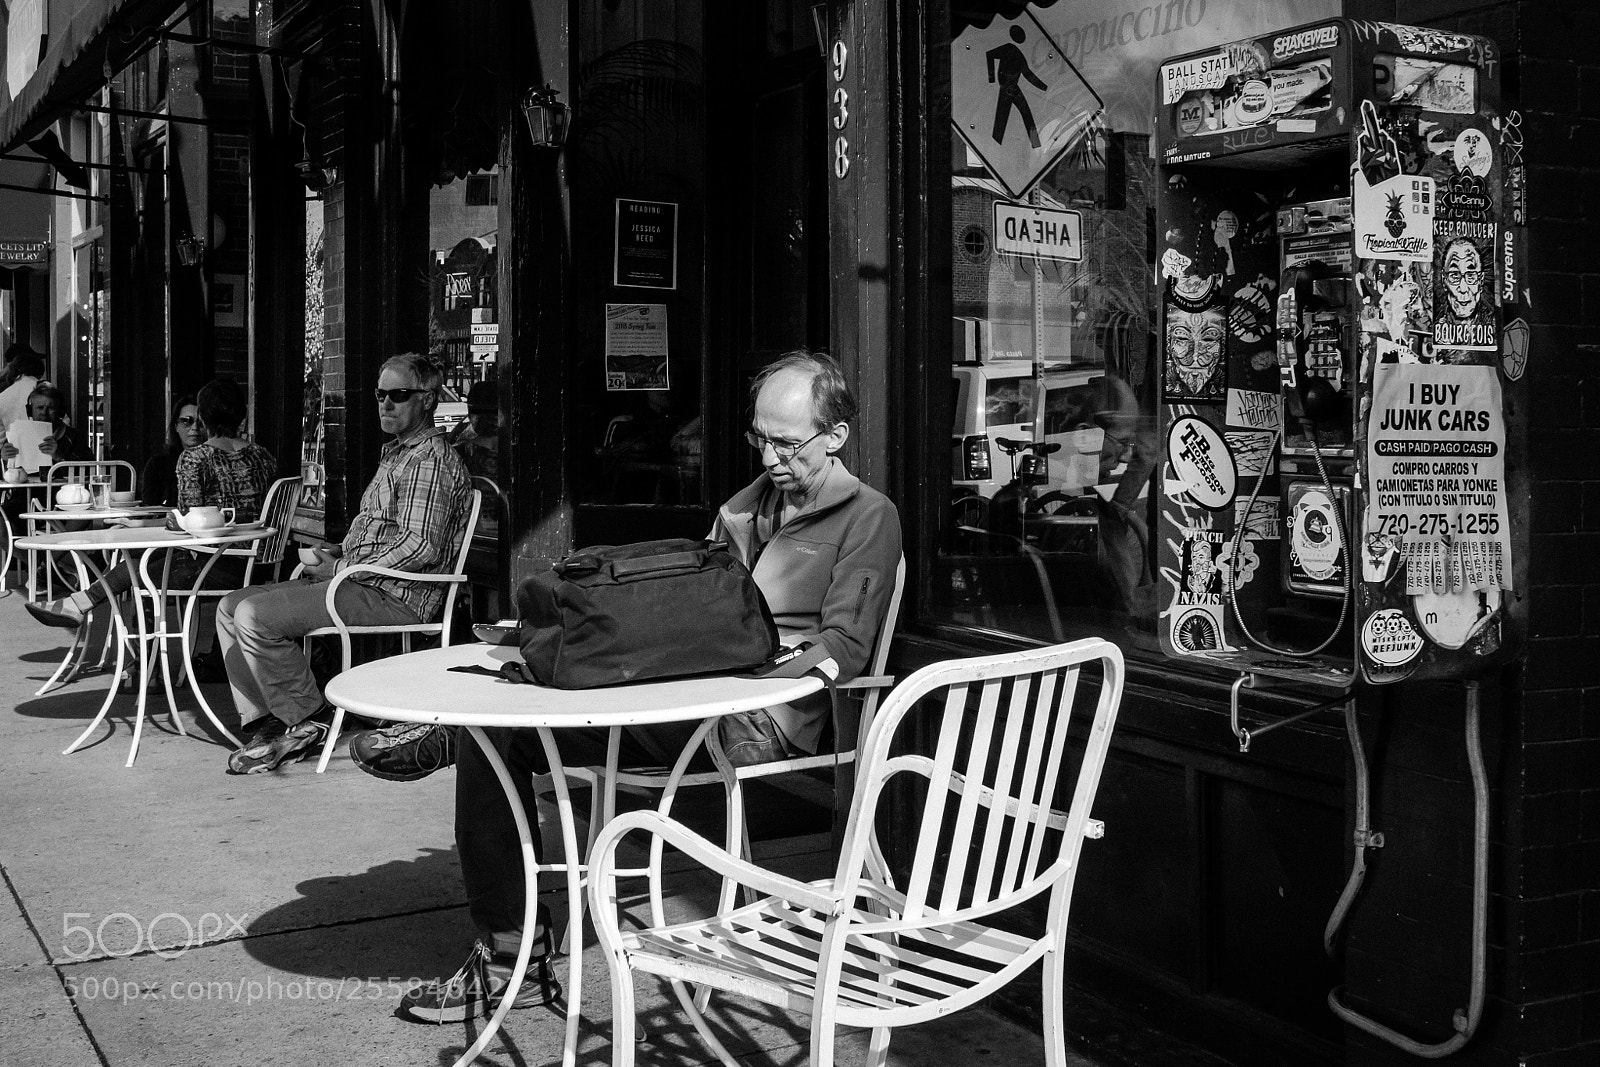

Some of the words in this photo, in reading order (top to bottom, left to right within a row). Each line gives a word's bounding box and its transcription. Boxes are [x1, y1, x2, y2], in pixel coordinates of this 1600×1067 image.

[1274, 26, 1339, 58] SHAKEWELL
[1168, 64, 1196, 80] BALL
[832, 40, 849, 179] 938
[631, 224, 661, 233] JESSICA
[1433, 220, 1454, 236] KEEP
[1456, 221, 1494, 239] BOULDER
[1502, 230, 1517, 301] Supreme
[1434, 325, 1494, 345] BOURGEOIS
[1409, 383, 1415, 405] I
[1421, 384, 1461, 405] BUY
[1380, 409, 1432, 431] JUNK
[1438, 410, 1490, 431] CARS
[1379, 442, 1407, 453] CASH
[1409, 443, 1431, 453] PAID
[1433, 443, 1460, 453] PAGO
[1462, 444, 1492, 454] CASH
[1392, 462, 1430, 475] COMPRO
[1432, 462, 1469, 475] CARROS
[1471, 462, 1479, 475] Y
[1377, 479, 1434, 492] CAMIONETAS
[1437, 479, 1460, 492] PARA
[1462, 479, 1498, 492] YONKE
[1378, 494, 1401, 509] (CON
[1403, 494, 1433, 506] TITULO
[1434, 494, 1440, 506] O
[1442, 494, 1457, 507] SIN
[1459, 494, 1496, 509] TITULO)
[1378, 513, 1499, 536] 720-275-1255
[1184, 531, 1224, 544] PUNCH
[1180, 591, 1221, 605] NAZIS
